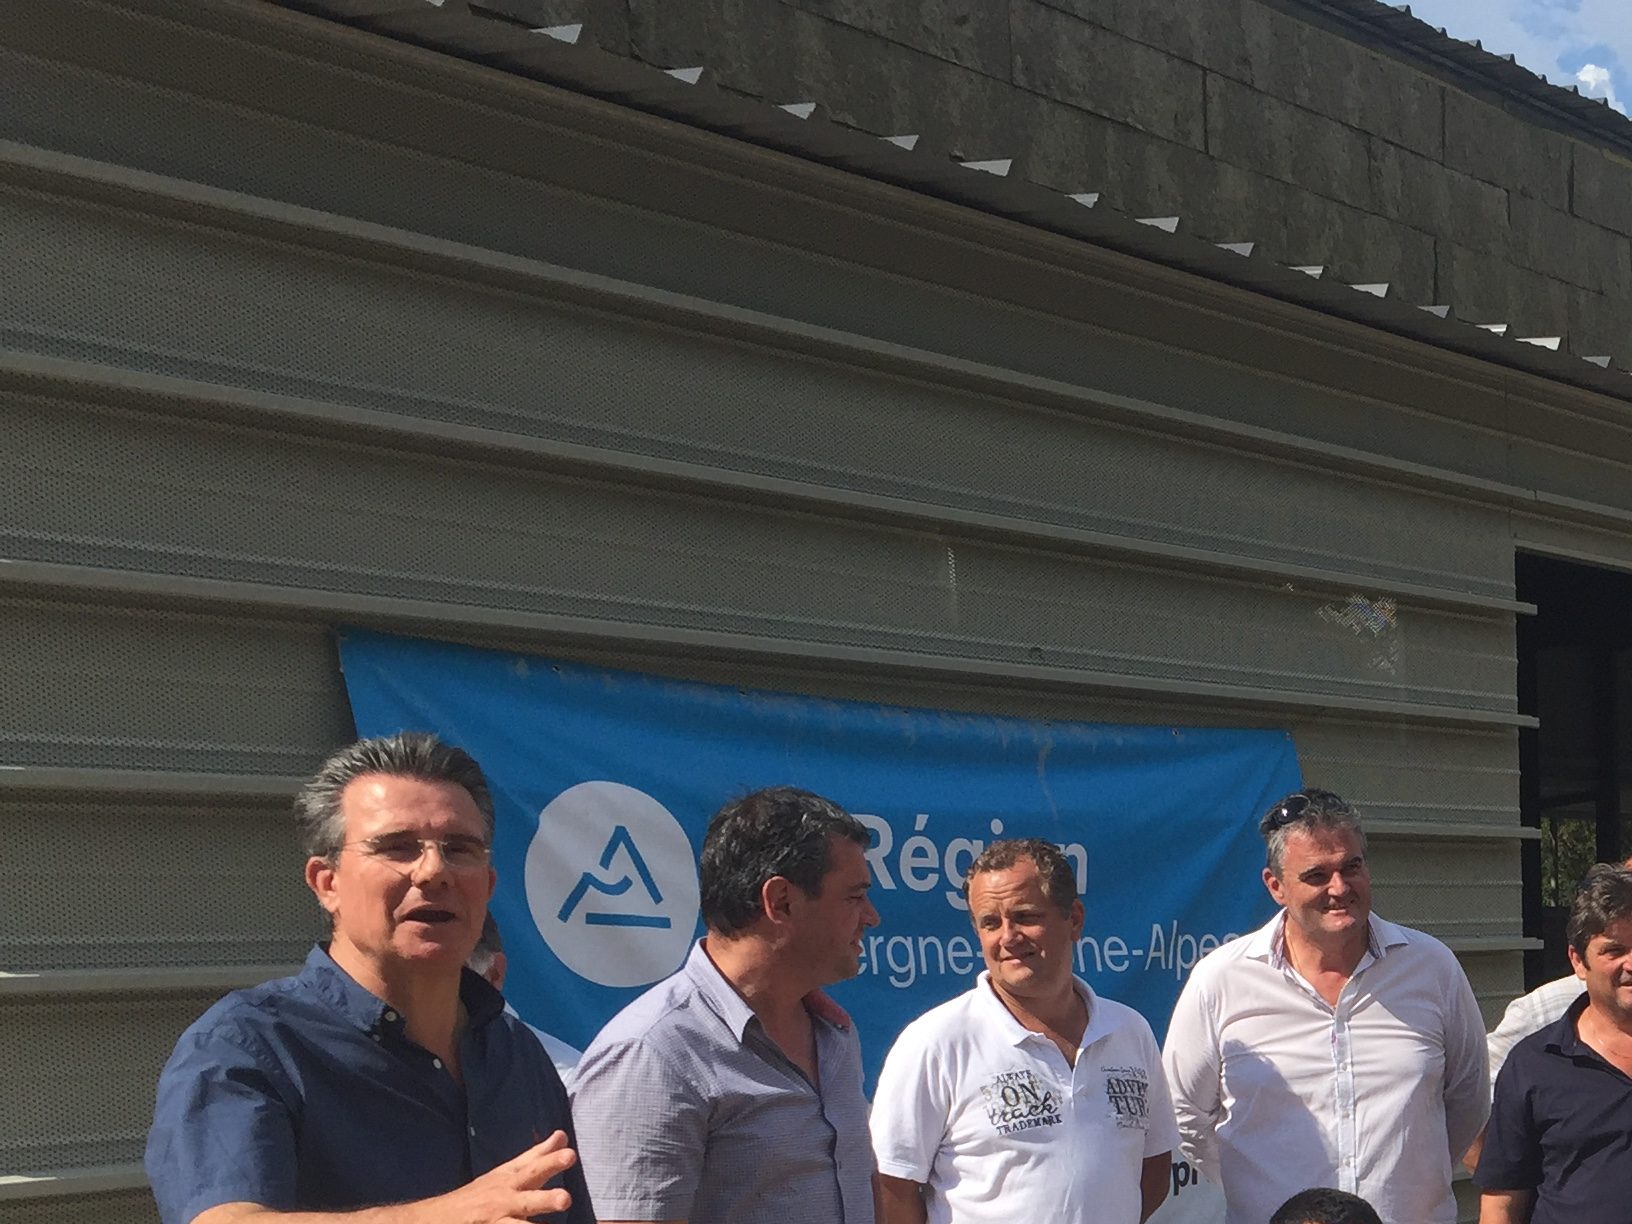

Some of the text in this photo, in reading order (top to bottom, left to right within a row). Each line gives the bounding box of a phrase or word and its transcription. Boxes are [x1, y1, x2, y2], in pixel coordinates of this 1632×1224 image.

[851, 814, 1088, 910] Régn
[986, 1091, 1058, 1125] track
[1001, 1079, 1040, 1107] ON
[996, 1114, 1063, 1135] TRADEMARK
